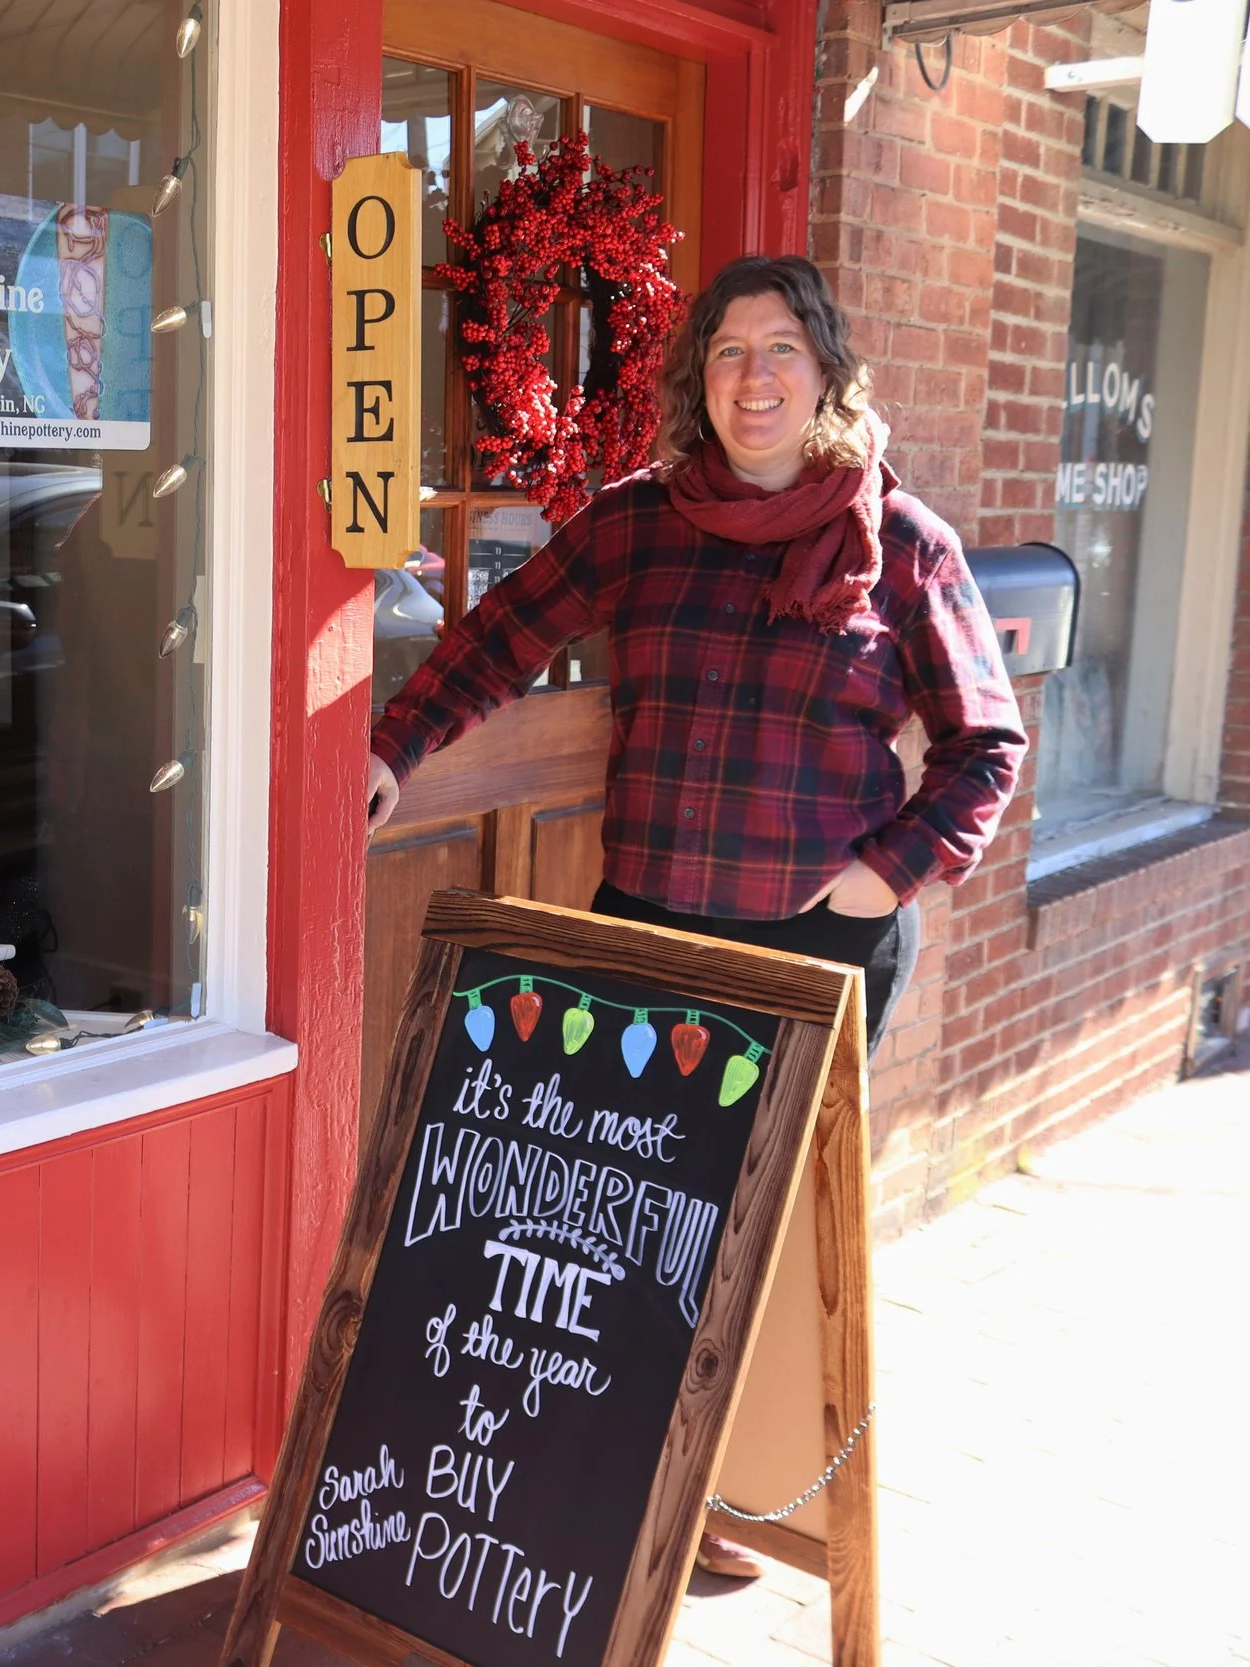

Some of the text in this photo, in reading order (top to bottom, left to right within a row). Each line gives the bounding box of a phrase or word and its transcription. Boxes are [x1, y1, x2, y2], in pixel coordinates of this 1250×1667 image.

[346, 195, 396, 535] OPEN
[1062, 361, 1156, 439] LLOMS
[23, 395, 46, 414] NC
[1092, 462, 1149, 506] SHOP
[452, 1058, 686, 1163] it's the most
[404, 1122, 719, 1329] WONDERFUL
[483, 1240, 613, 1341] TIME
[425, 1303, 612, 1418] of the year
[458, 1384, 510, 1446] to
[319, 1444, 404, 1511] Sarah
[426, 1444, 515, 1522] BUY
[305, 1499, 412, 1569] Sunshine
